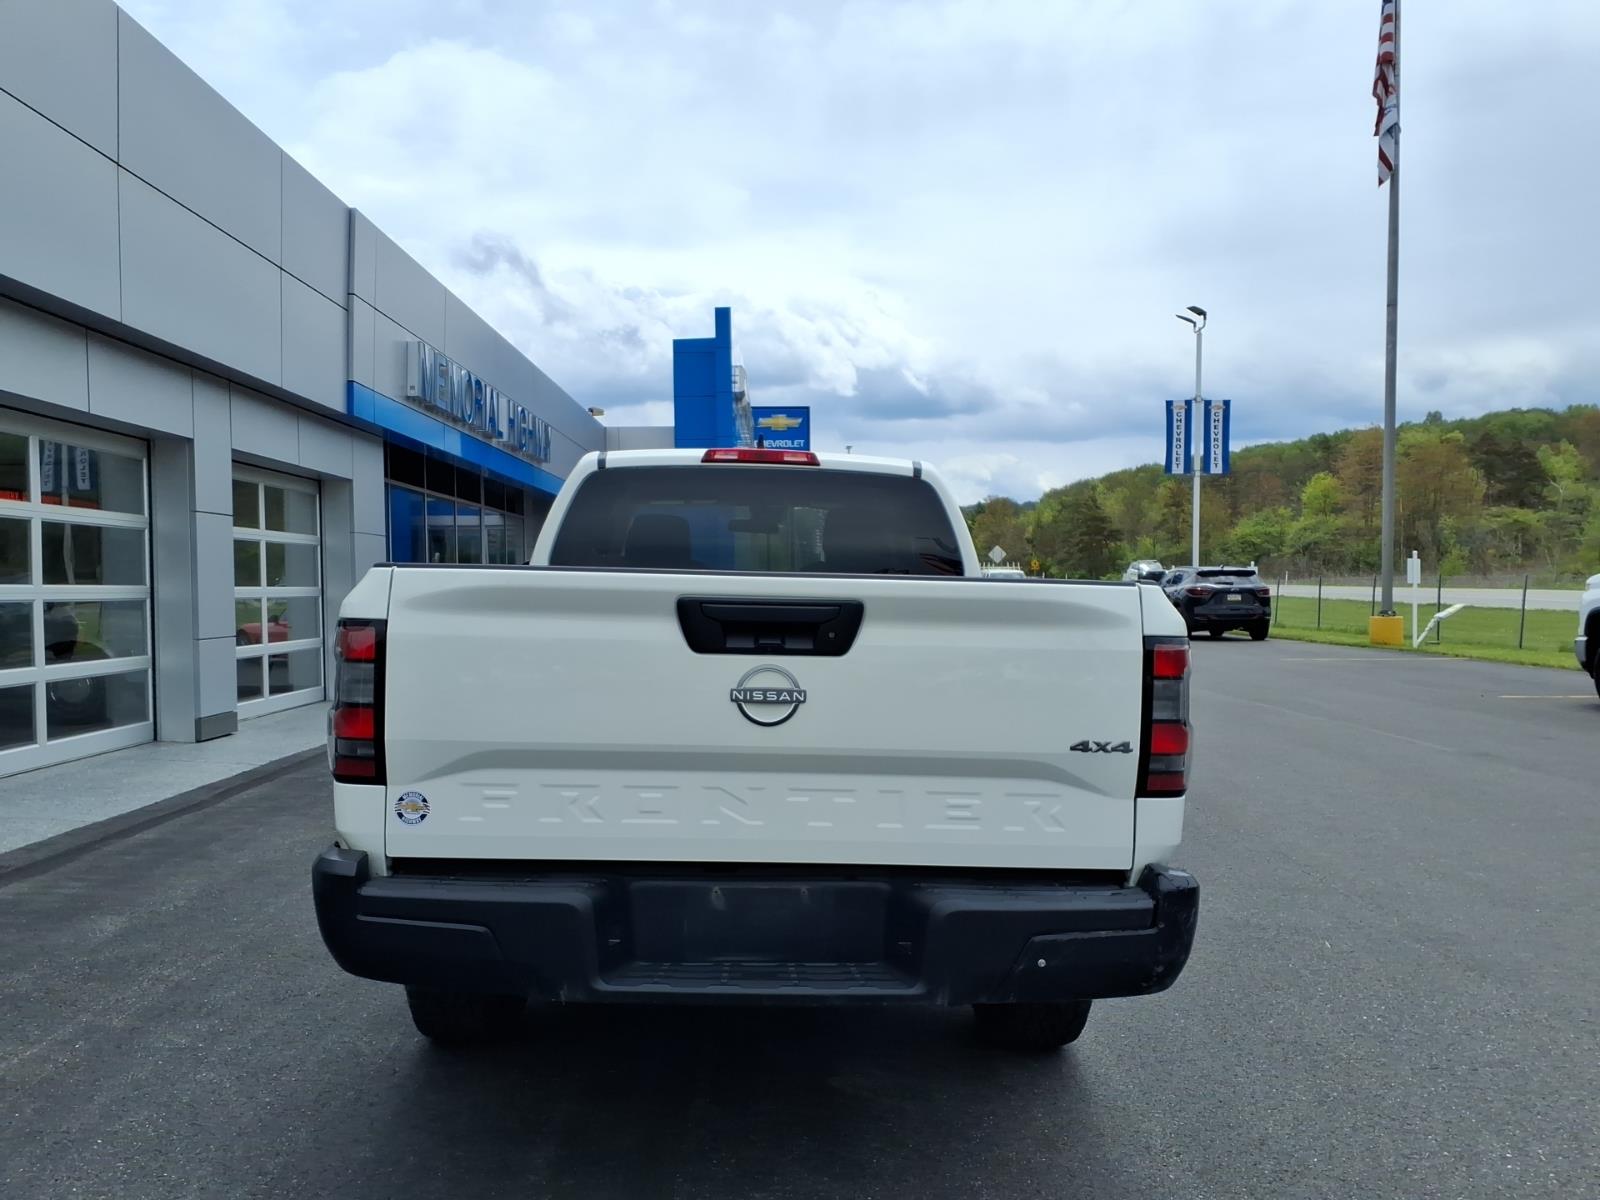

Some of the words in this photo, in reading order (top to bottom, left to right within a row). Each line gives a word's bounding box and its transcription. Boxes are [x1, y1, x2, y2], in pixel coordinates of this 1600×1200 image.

[407, 341, 508, 441] MEMORIAL
[1175, 411, 1183, 469] CHEVROLET
[732, 690, 805, 702] NISSAN
[458, 783, 1066, 833] FRONTIER
